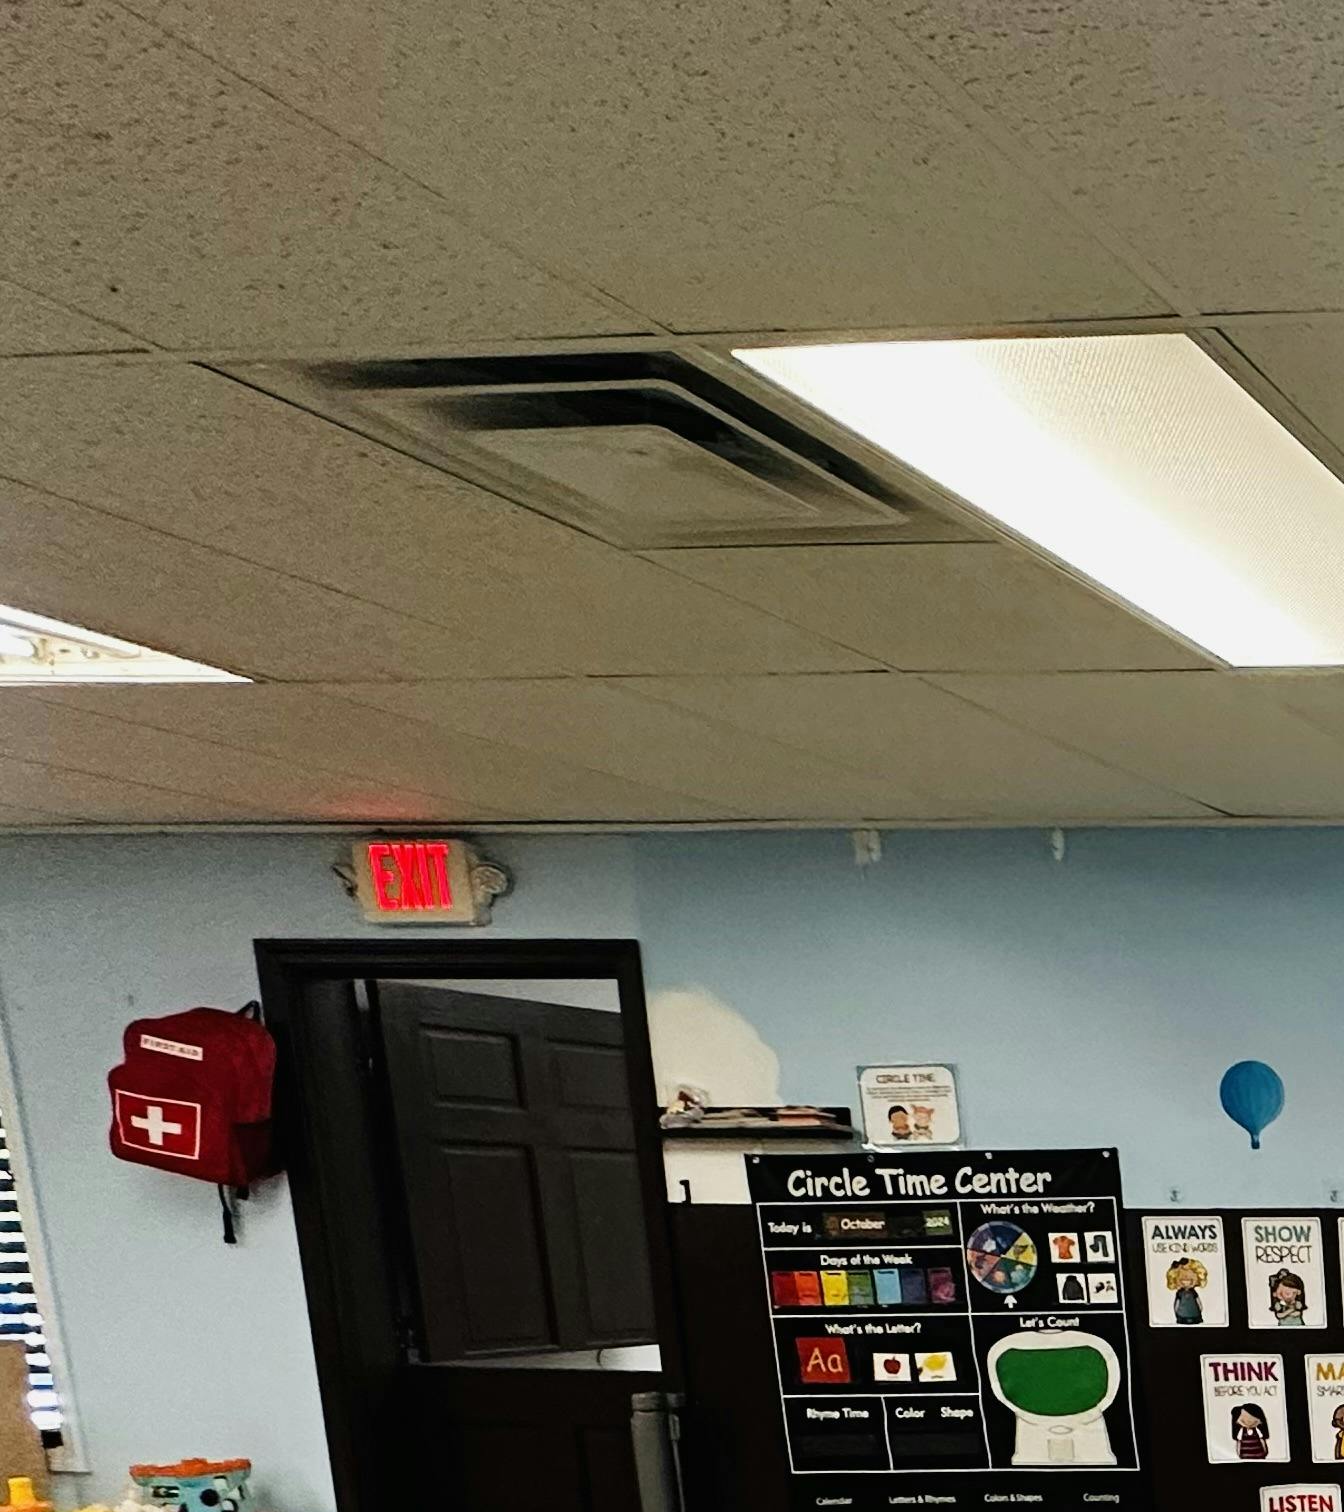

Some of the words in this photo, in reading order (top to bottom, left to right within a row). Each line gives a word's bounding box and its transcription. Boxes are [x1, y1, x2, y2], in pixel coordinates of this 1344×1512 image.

[368, 844, 453, 910] EXIT
[144, 1038, 176, 1051] FIRST
[179, 1047, 199, 1056] AID
[876, 1074, 910, 1084] CIRCLE
[787, 1167, 870, 1198] Circle
[874, 1168, 948, 1197] Time
[955, 1166, 1051, 1194] Center
[980, 1204, 1019, 1214] What's
[1022, 1203, 1039, 1214] the
[1041, 1201, 1095, 1214] Weather?
[768, 1222, 799, 1235] Today
[802, 1222, 812, 1234] is
[840, 1217, 886, 1230] October
[1151, 1224, 1218, 1240] ALWAYS
[1254, 1225, 1312, 1243] SHOW
[820, 1255, 847, 1267] Days
[850, 1254, 862, 1265] of
[863, 1254, 881, 1265] the
[882, 1253, 913, 1265] Week
[1256, 1245, 1312, 1264] RESPECT
[825, 1323, 863, 1334] What's
[864, 1323, 884, 1334] the
[885, 1322, 922, 1334] Letter?
[1019, 1317, 1045, 1328] Let's
[1047, 1316, 1080, 1327] Count
[806, 1347, 843, 1373] Aa
[1208, 1361, 1278, 1382] THINK
[1214, 1385, 1243, 1397] BEFORE
[1245, 1385, 1262, 1396] YOU
[1264, 1385, 1277, 1396] ACT
[806, 1407, 840, 1421] Rhyme
[842, 1407, 870, 1419] Time
[895, 1406, 926, 1419] Color
[940, 1406, 974, 1420] Shape
